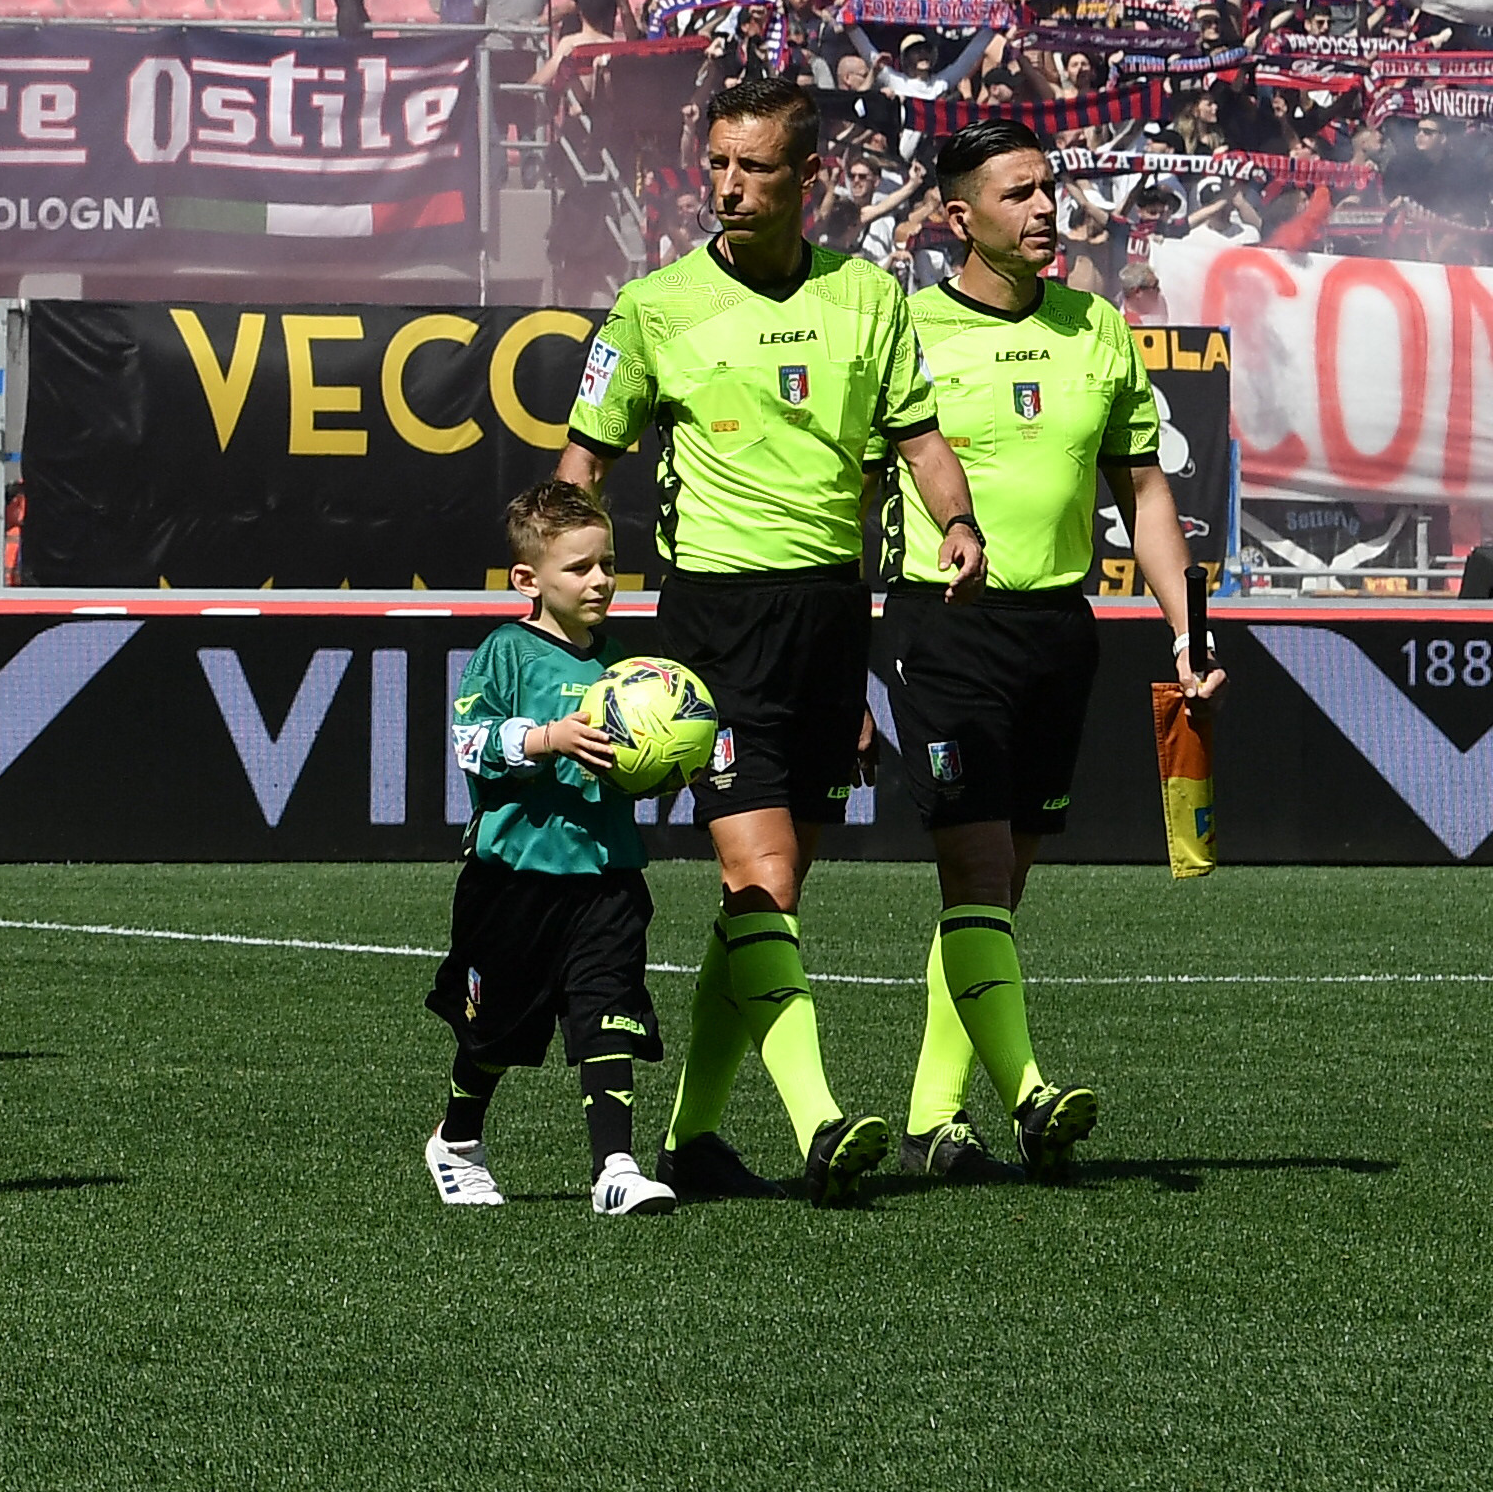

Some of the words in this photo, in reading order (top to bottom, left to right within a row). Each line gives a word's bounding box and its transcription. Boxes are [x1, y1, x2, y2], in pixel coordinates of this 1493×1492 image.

[125, 53, 462, 165] Ostile
[1050, 149, 1135, 175] FORZA
[1143, 155, 1256, 182] BOLOGNA
[759, 328, 818, 346] LEGEA
[1130, 327, 1229, 372] OLA
[994, 348, 1051, 364] LEGEA
[169, 309, 595, 455] VECC
[600, 1014, 647, 1037] LEGEA
